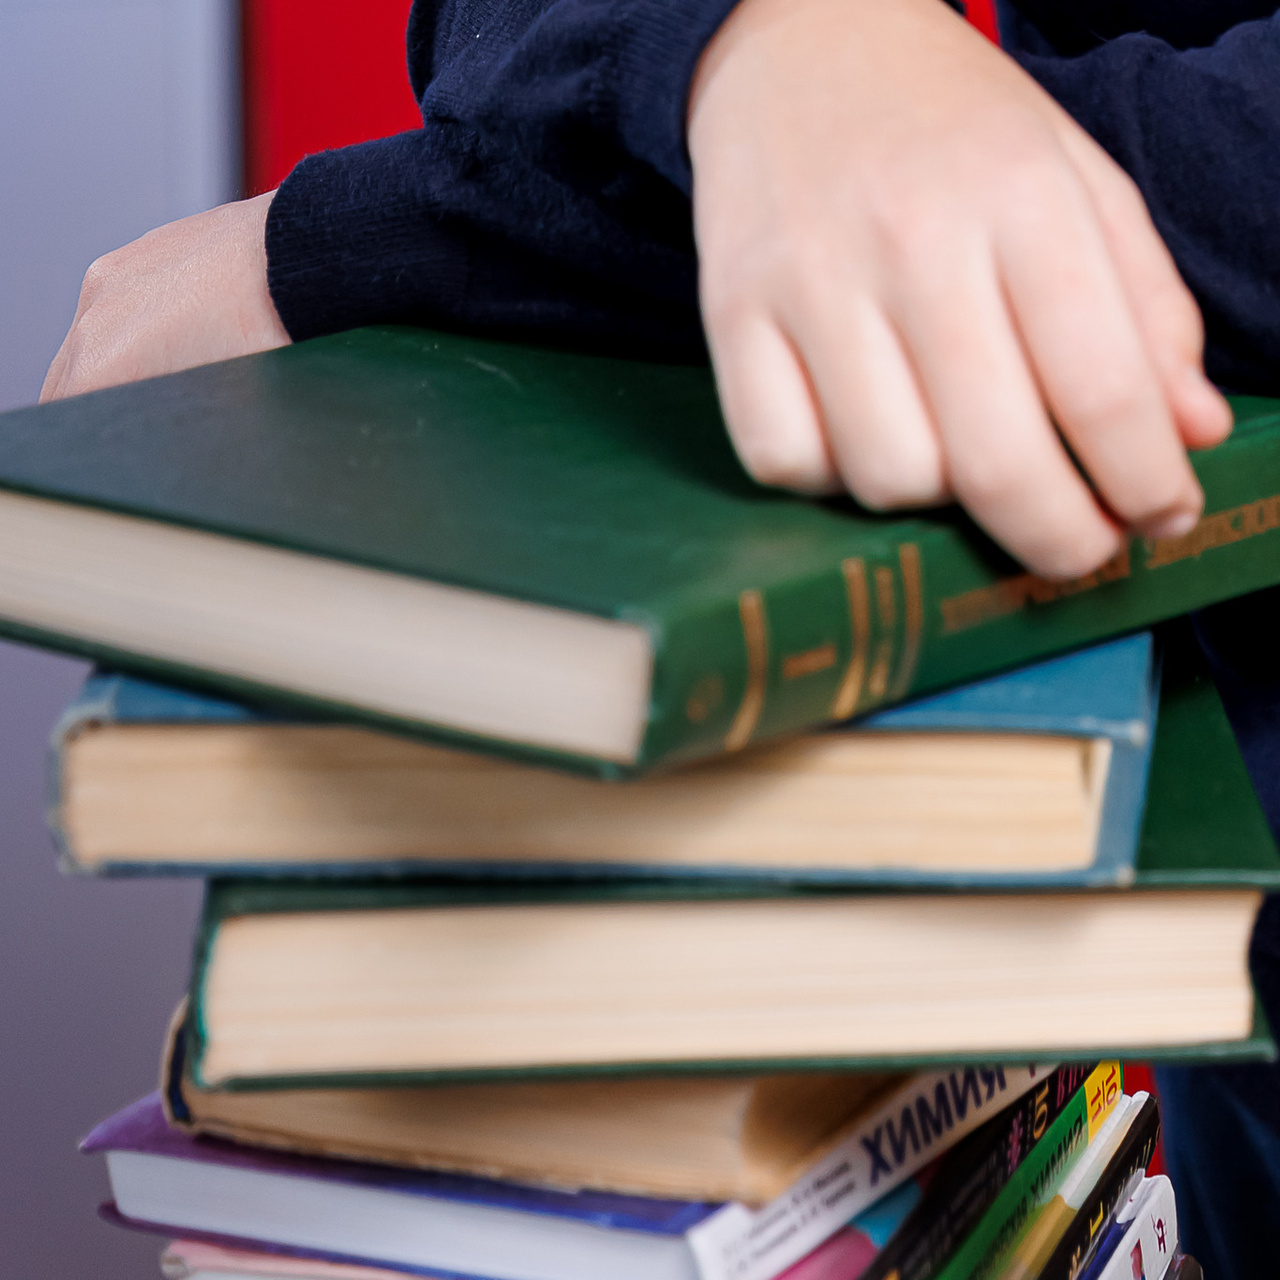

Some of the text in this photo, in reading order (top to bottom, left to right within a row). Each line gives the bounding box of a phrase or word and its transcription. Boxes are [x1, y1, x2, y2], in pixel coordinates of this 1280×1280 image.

[1090, 1085, 1103, 1124] 11
[1105, 1065, 1118, 1106] 10
[860, 1063, 1007, 1187] ХИМИЯ
